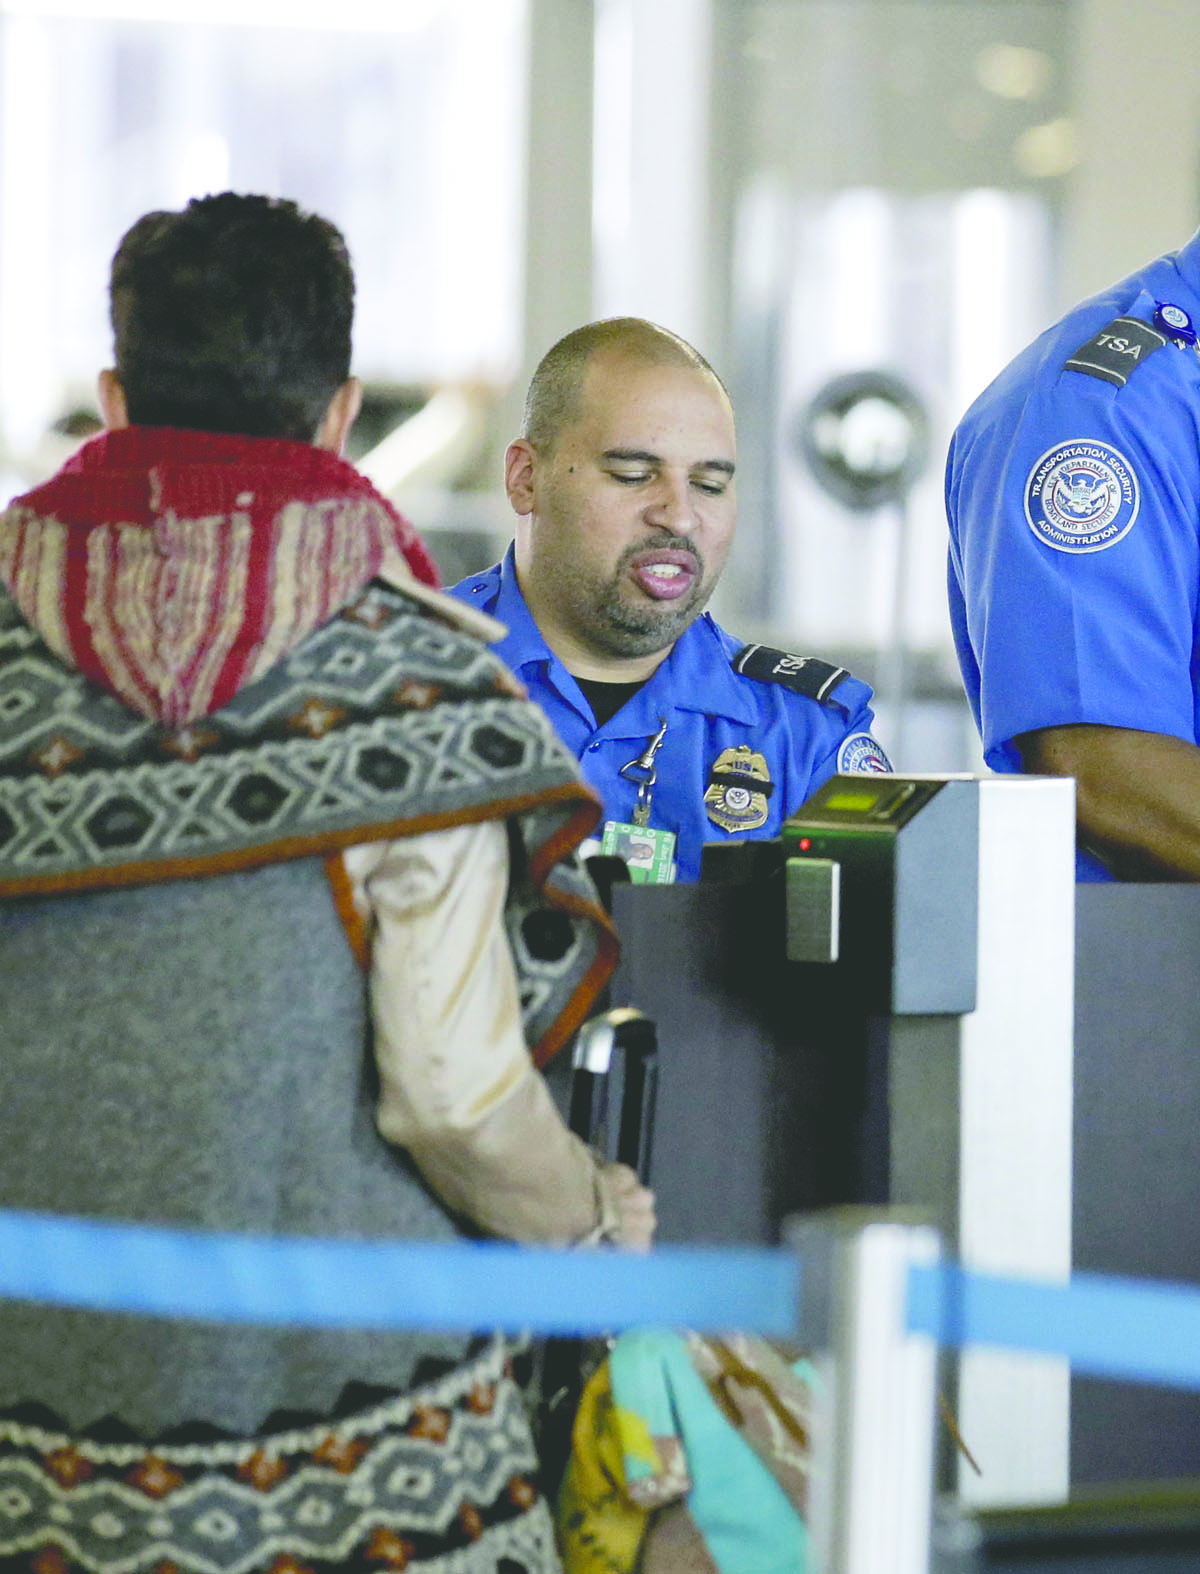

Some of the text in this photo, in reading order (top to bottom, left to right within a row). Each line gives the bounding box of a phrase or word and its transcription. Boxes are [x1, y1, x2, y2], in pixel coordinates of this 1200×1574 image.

[1096, 334, 1142, 360] TSA
[1032, 447, 1132, 504] TRANSPORTATION SECURITY
[1045, 498, 1115, 530] HOMELAND SECURITY
[1038, 519, 1119, 545] ADMINISTRATION
